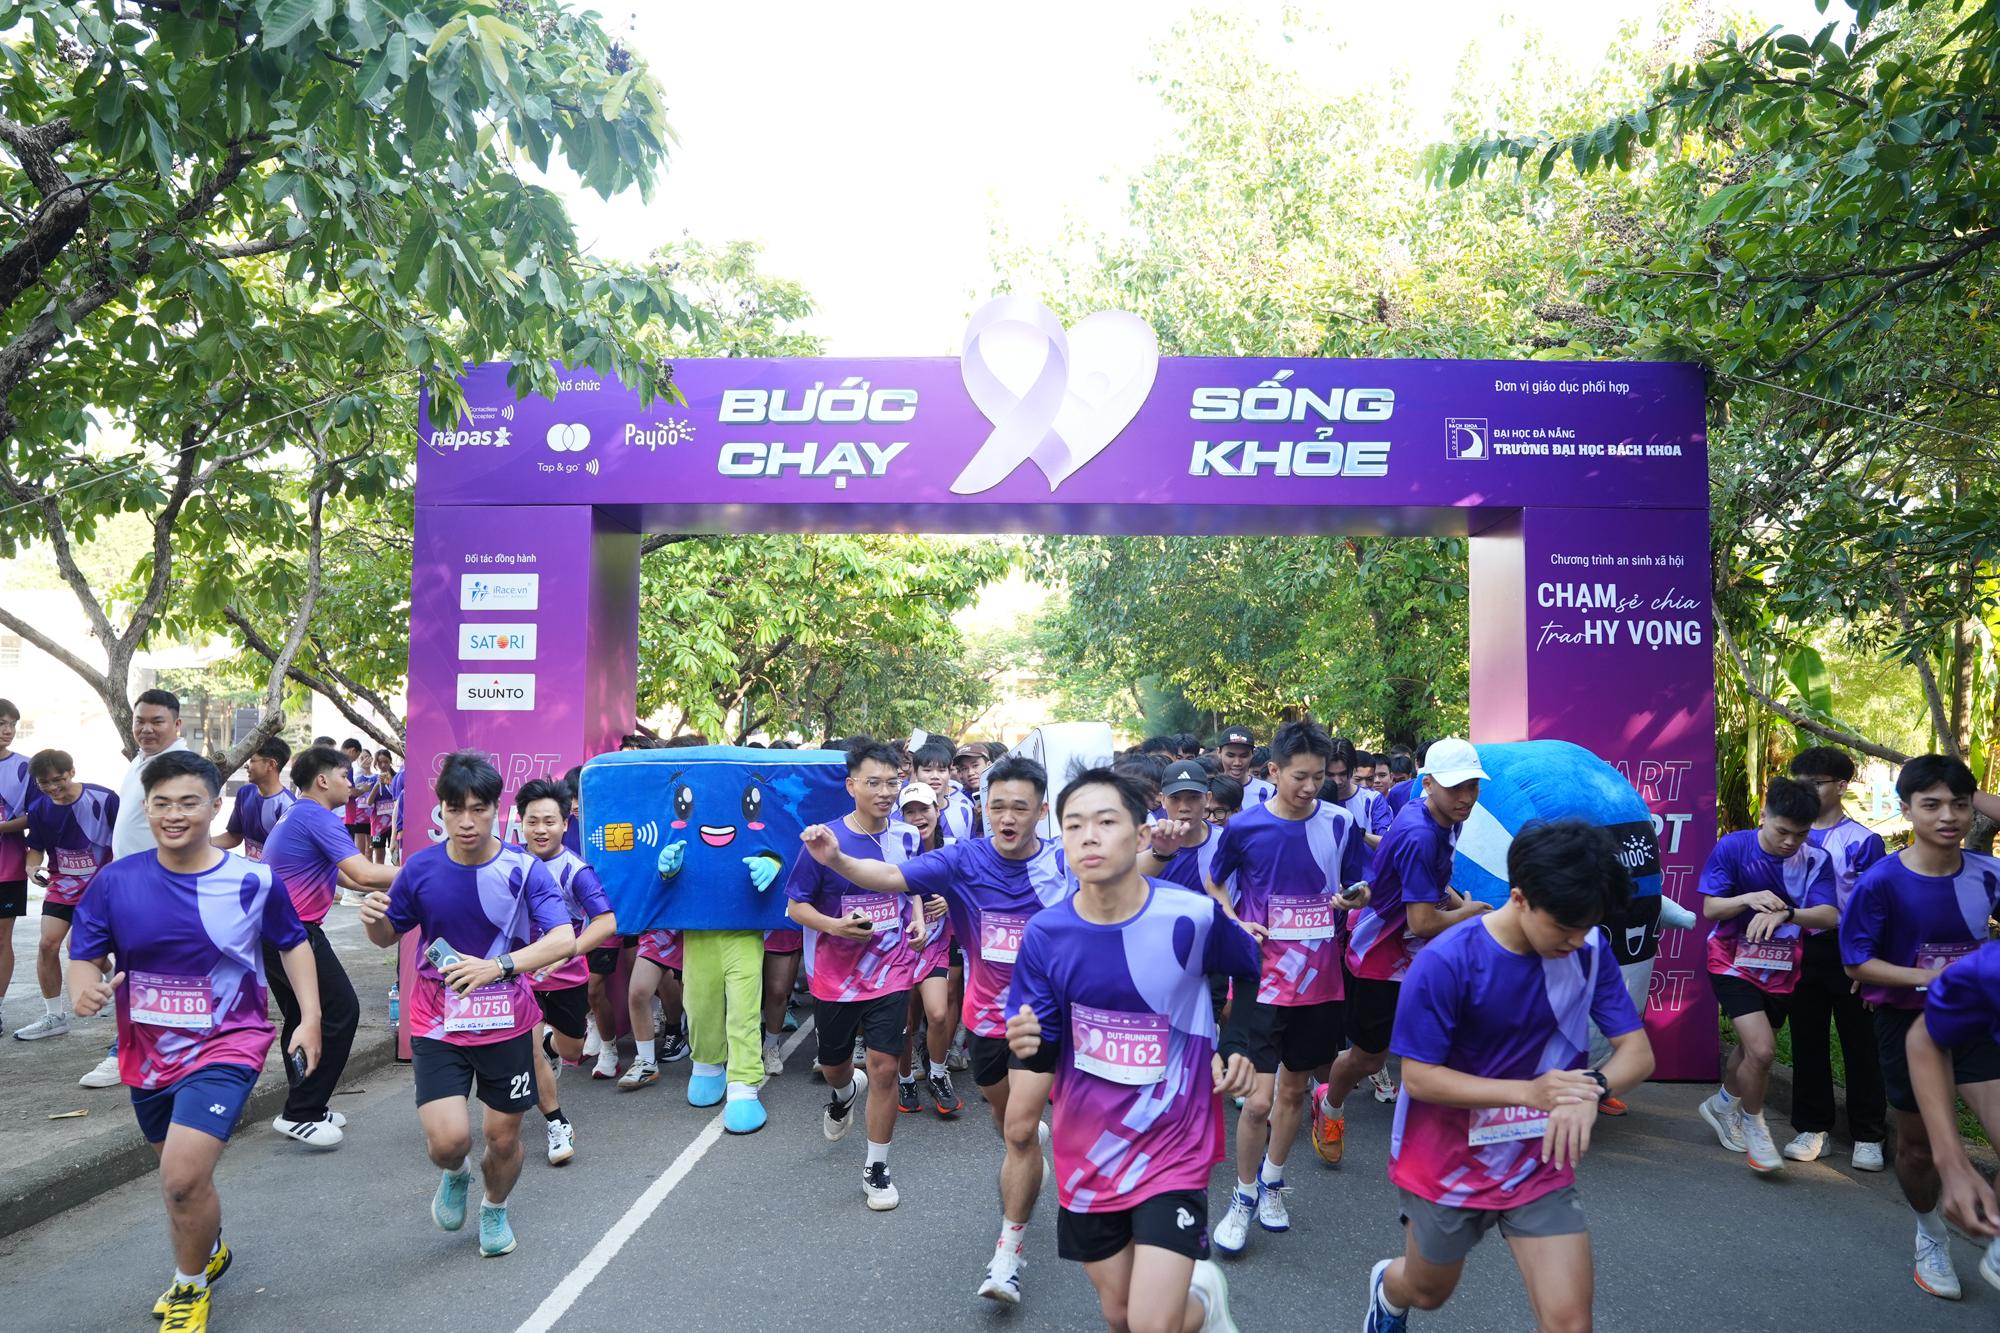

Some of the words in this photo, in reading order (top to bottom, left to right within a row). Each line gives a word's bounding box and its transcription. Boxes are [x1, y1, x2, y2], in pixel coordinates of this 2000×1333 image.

[561, 379, 572, 391] tổ
[575, 379, 601, 391] chức
[1495, 380, 1517, 392] Đơn
[1520, 380, 1530, 395] vị
[1533, 380, 1556, 394] giáo
[1559, 381, 1580, 395] dục
[1582, 379, 1606, 395] phối
[1609, 381, 1630, 395] hợp
[718, 377, 919, 423] BƯỚC
[1189, 369, 1395, 422] SỐNG
[430, 430, 492, 451] napas
[625, 423, 679, 451] Payoo
[1494, 429, 1510, 439] ĐẠI
[1512, 430, 1531, 440] HỌC
[1533, 428, 1546, 438] ĐÀ
[1548, 427, 1575, 439] NẴNG
[1188, 427, 1392, 477] KHỎE
[1494, 443, 1549, 455] TRƯỜNG
[1552, 445, 1575, 458] ĐẠI
[1579, 445, 1604, 459] HỌC
[1607, 443, 1643, 456] BÁCH
[1646, 445, 1682, 456] KHOA
[537, 462, 555, 473] Tap
[557, 463, 564, 472] &
[566, 464, 579, 474] go
[718, 442, 910, 489] CHẠY
[465, 553, 478, 563] Đối
[480, 554, 493, 563] tác
[495, 553, 515, 565] đồng
[516, 553, 536, 563] hành
[1550, 554, 1589, 567] Chương
[1592, 554, 1615, 566] trình
[1617, 557, 1629, 566] an
[1631, 555, 1652, 566] sinh
[1654, 556, 1667, 566] xã
[1669, 555, 1684, 568] hội
[493, 585, 528, 594] iRace.vn
[1537, 582, 1617, 613] CHẠM
[1650, 587, 1702, 611] chia
[470, 634, 525, 649] SATORI
[1536, 620, 1586, 652] trao
[1584, 620, 1620, 645] HY
[1627, 620, 1702, 651] VỌNG
[468, 688, 524, 699] SUUNTO
[1295, 912, 1331, 927] 0624
[1759, 949, 1792, 960] 0587
[161, 996, 207, 1013] 0180
[472, 1000, 511, 1017] 0750
[1106, 1031, 1158, 1042] DUT-RUNNER
[1105, 1040, 1162, 1065] 0162
[510, 1071, 531, 1099] 22
